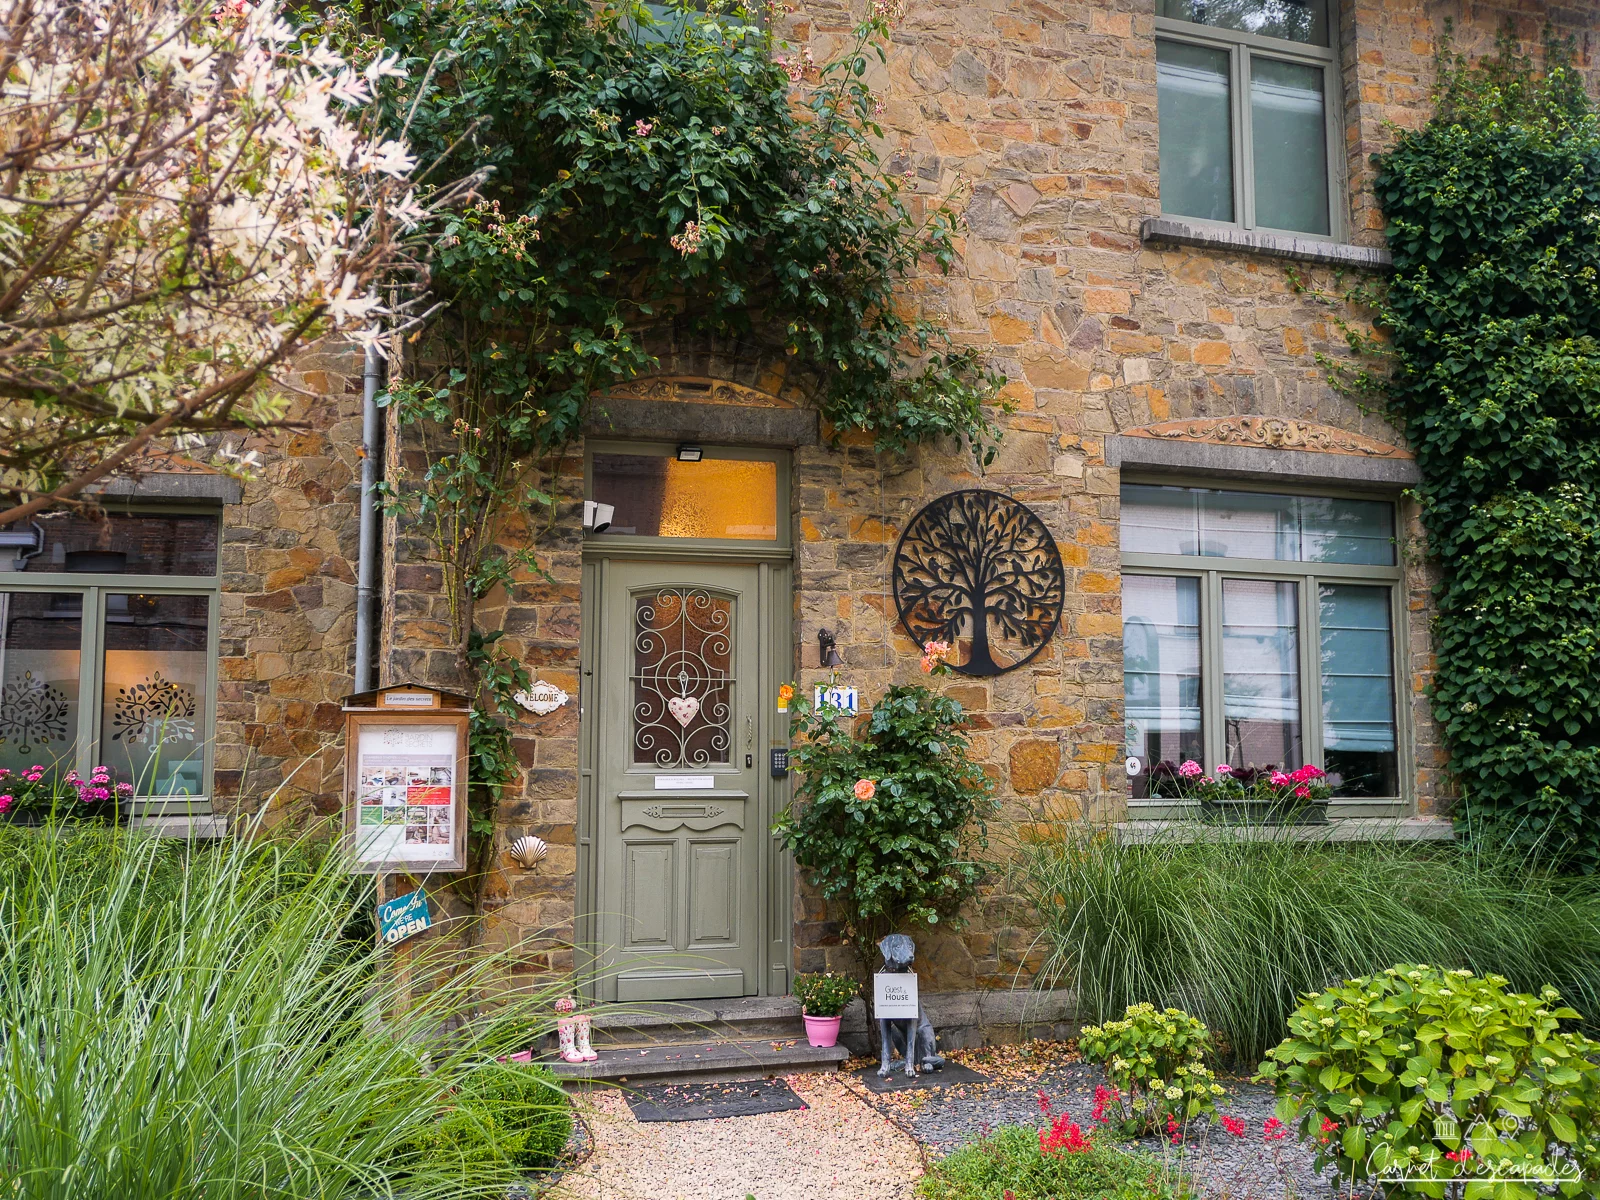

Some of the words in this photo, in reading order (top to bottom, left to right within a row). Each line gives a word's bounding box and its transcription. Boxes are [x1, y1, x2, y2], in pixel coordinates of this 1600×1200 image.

[818, 692, 854, 711] 131
[384, 905, 408, 923] Come
[387, 917, 427, 943] OPEN
